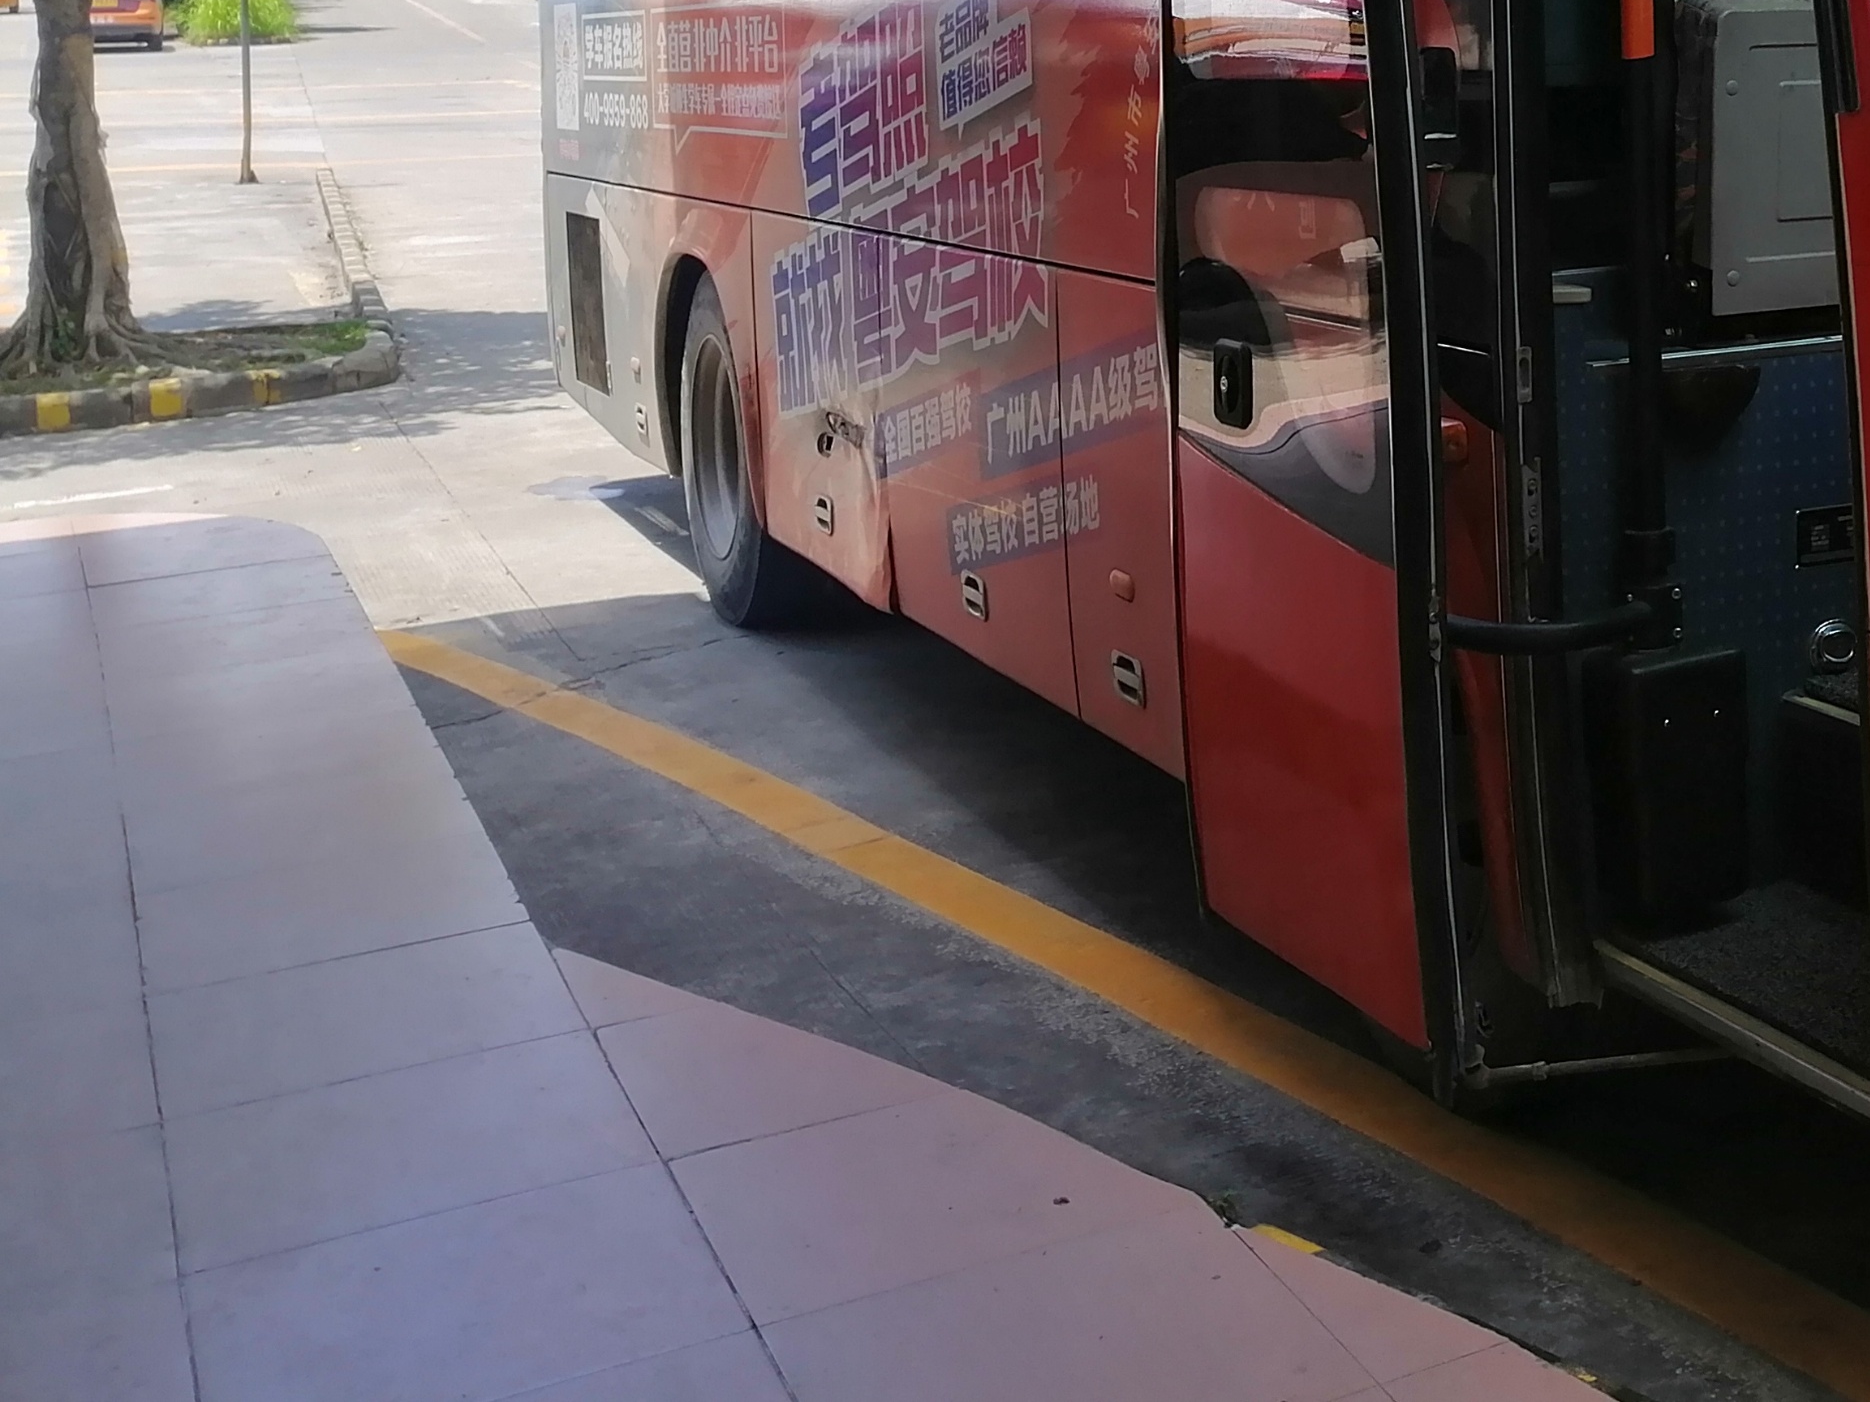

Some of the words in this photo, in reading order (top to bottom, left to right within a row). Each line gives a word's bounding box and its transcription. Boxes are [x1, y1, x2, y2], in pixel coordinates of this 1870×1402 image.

[584, 21, 644, 70] 学车报名热线
[941, 22, 1028, 121] 值得您信赖
[584, 91, 649, 130] 400-9959-868
[772, 123, 1048, 418] 就找粤安驾校
[883, 381, 972, 464] 全国百强驾校
[986, 342, 1169, 466] 广州AAAA级驾
